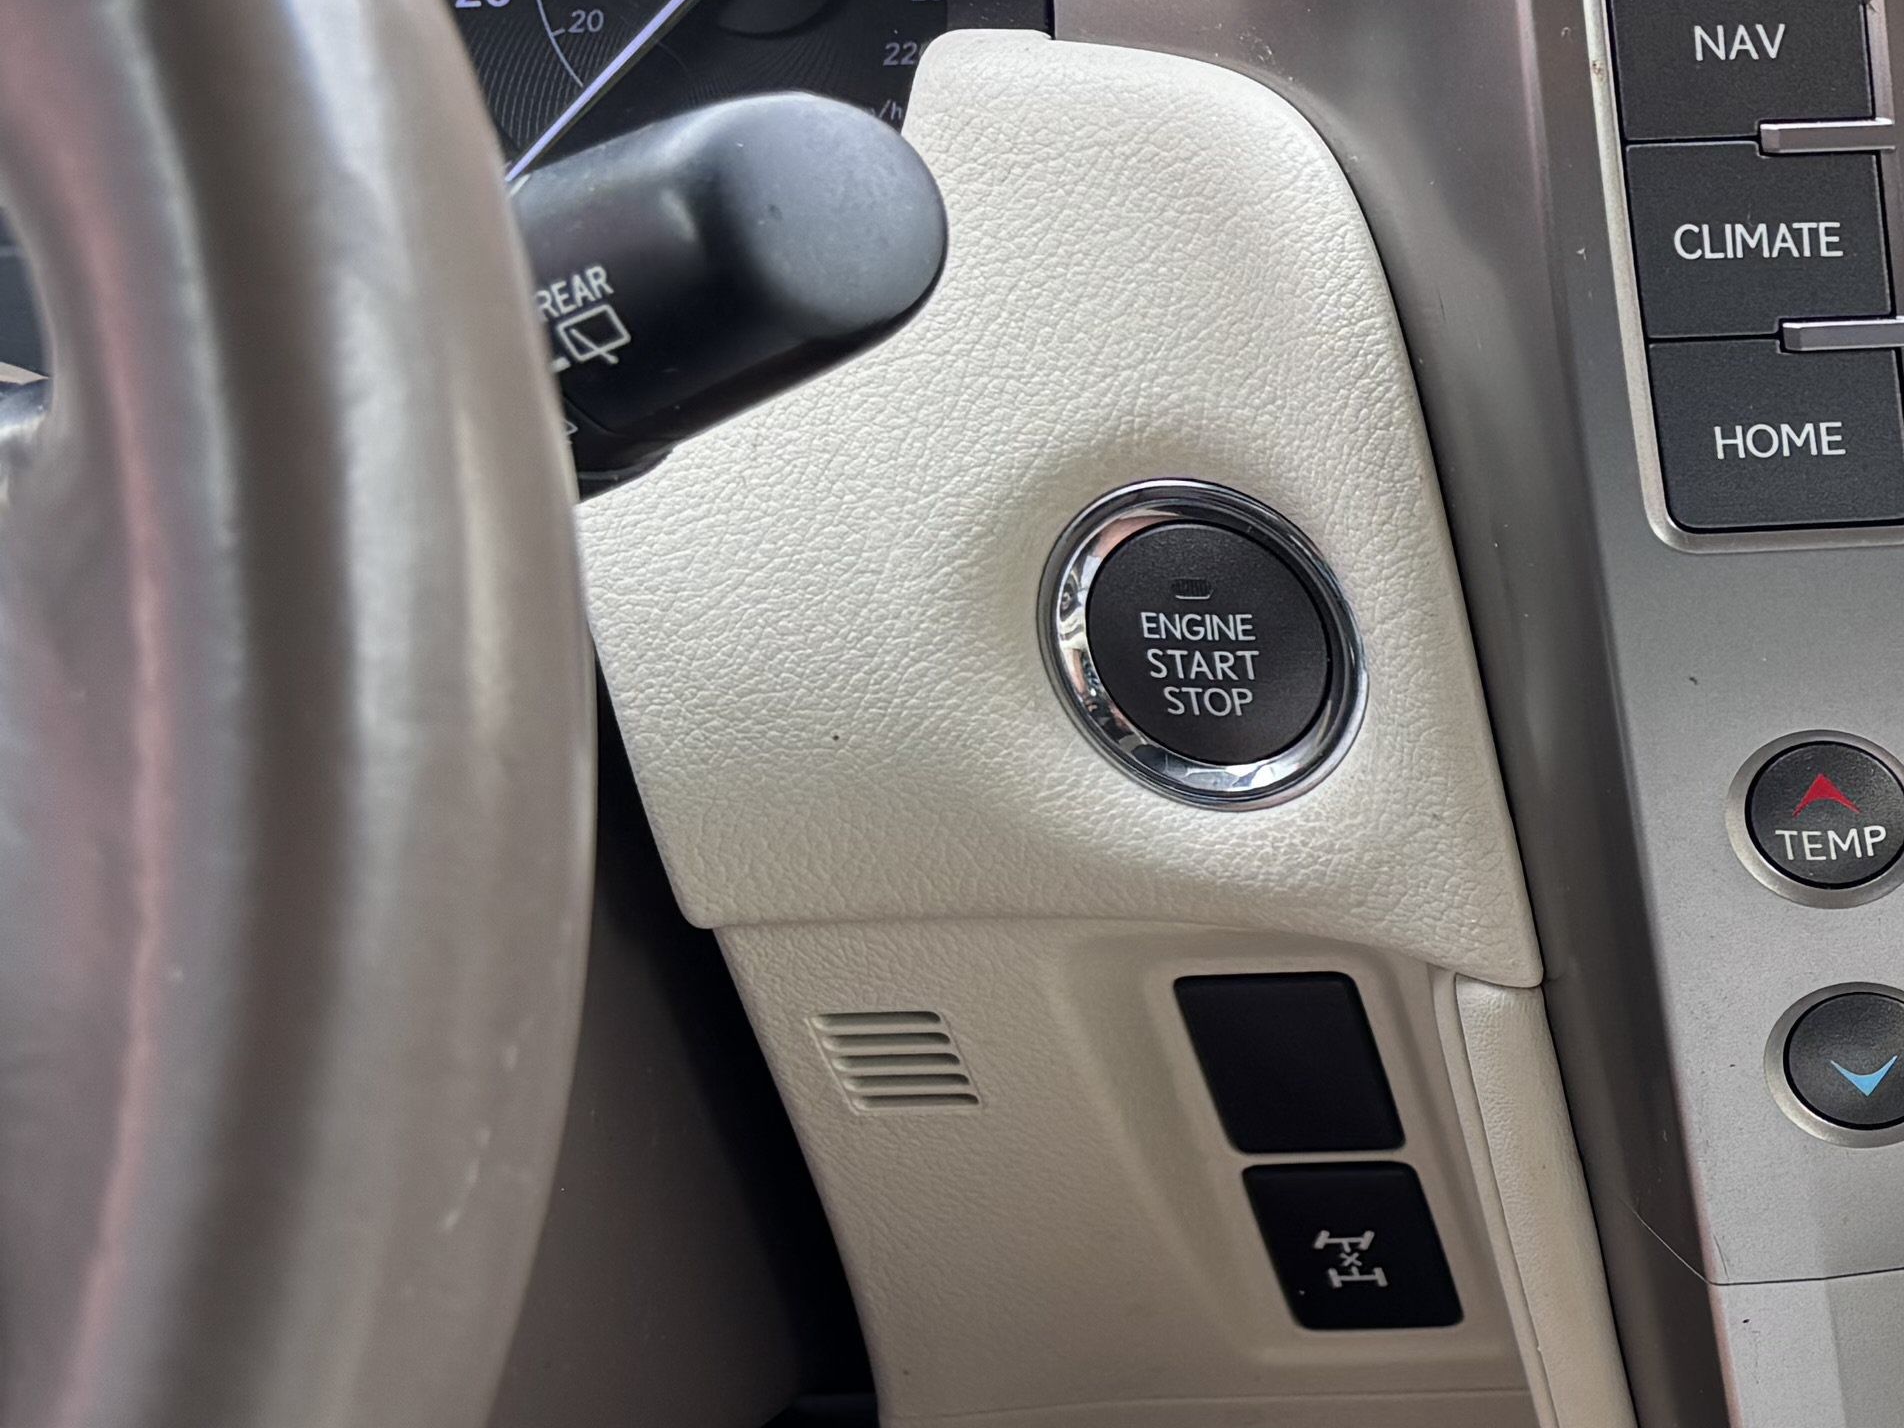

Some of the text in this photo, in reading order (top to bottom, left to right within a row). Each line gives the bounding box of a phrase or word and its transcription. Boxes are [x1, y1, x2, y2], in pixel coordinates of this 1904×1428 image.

[568, 8, 605, 34] 20
[882, 41, 917, 67] 22
[1692, 22, 1787, 63] NAV
[1673, 220, 1845, 262] CLIMATE
[536, 265, 615, 321] REAR
[1714, 421, 1848, 460] HOME
[1140, 611, 1257, 642] ENGINE
[1146, 648, 1260, 681] START
[1163, 686, 1253, 717] STOP
[1774, 824, 1888, 863] TEMP
